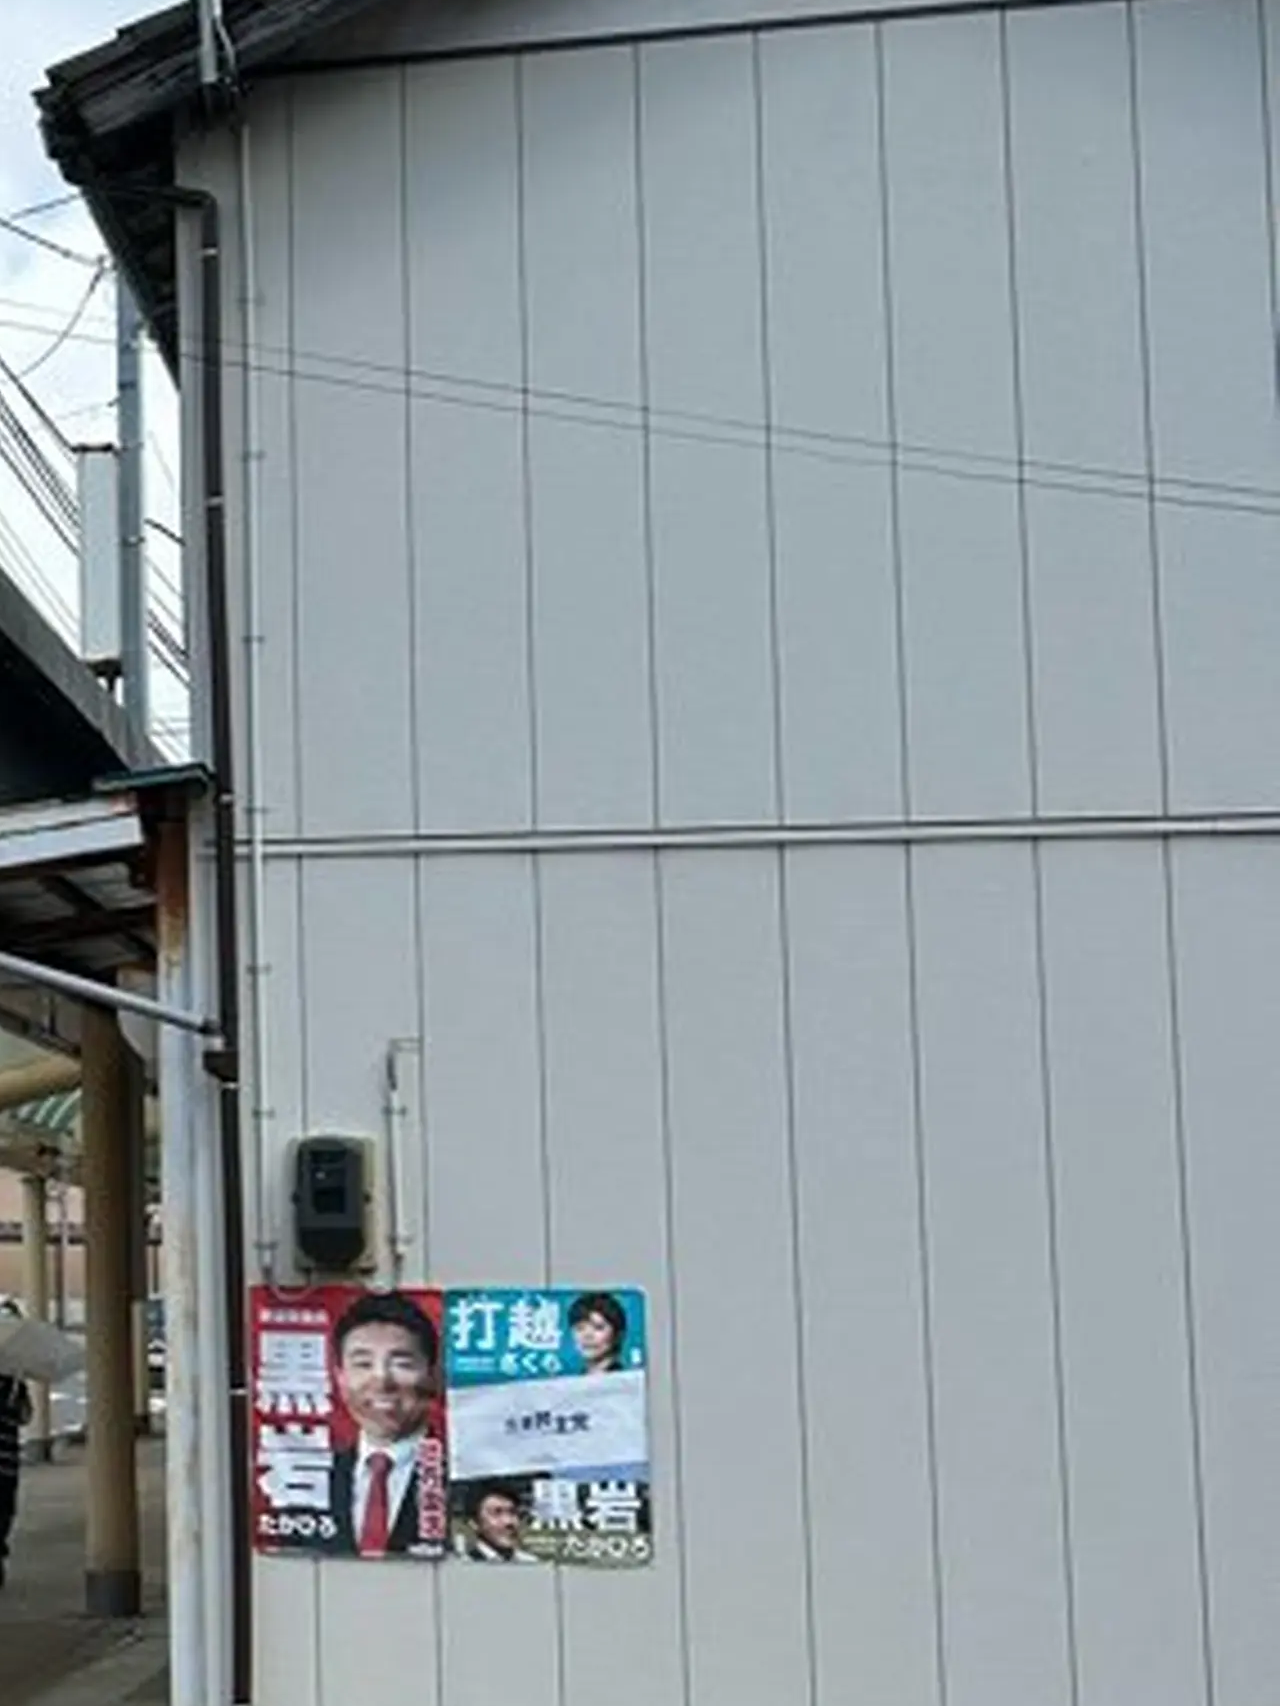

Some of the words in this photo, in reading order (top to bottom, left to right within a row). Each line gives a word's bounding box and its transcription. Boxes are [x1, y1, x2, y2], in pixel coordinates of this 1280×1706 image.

[449, 1296, 564, 1352] 打越
[256, 1330, 334, 1510] 黒岩
[529, 1476, 642, 1533] 黒岩
